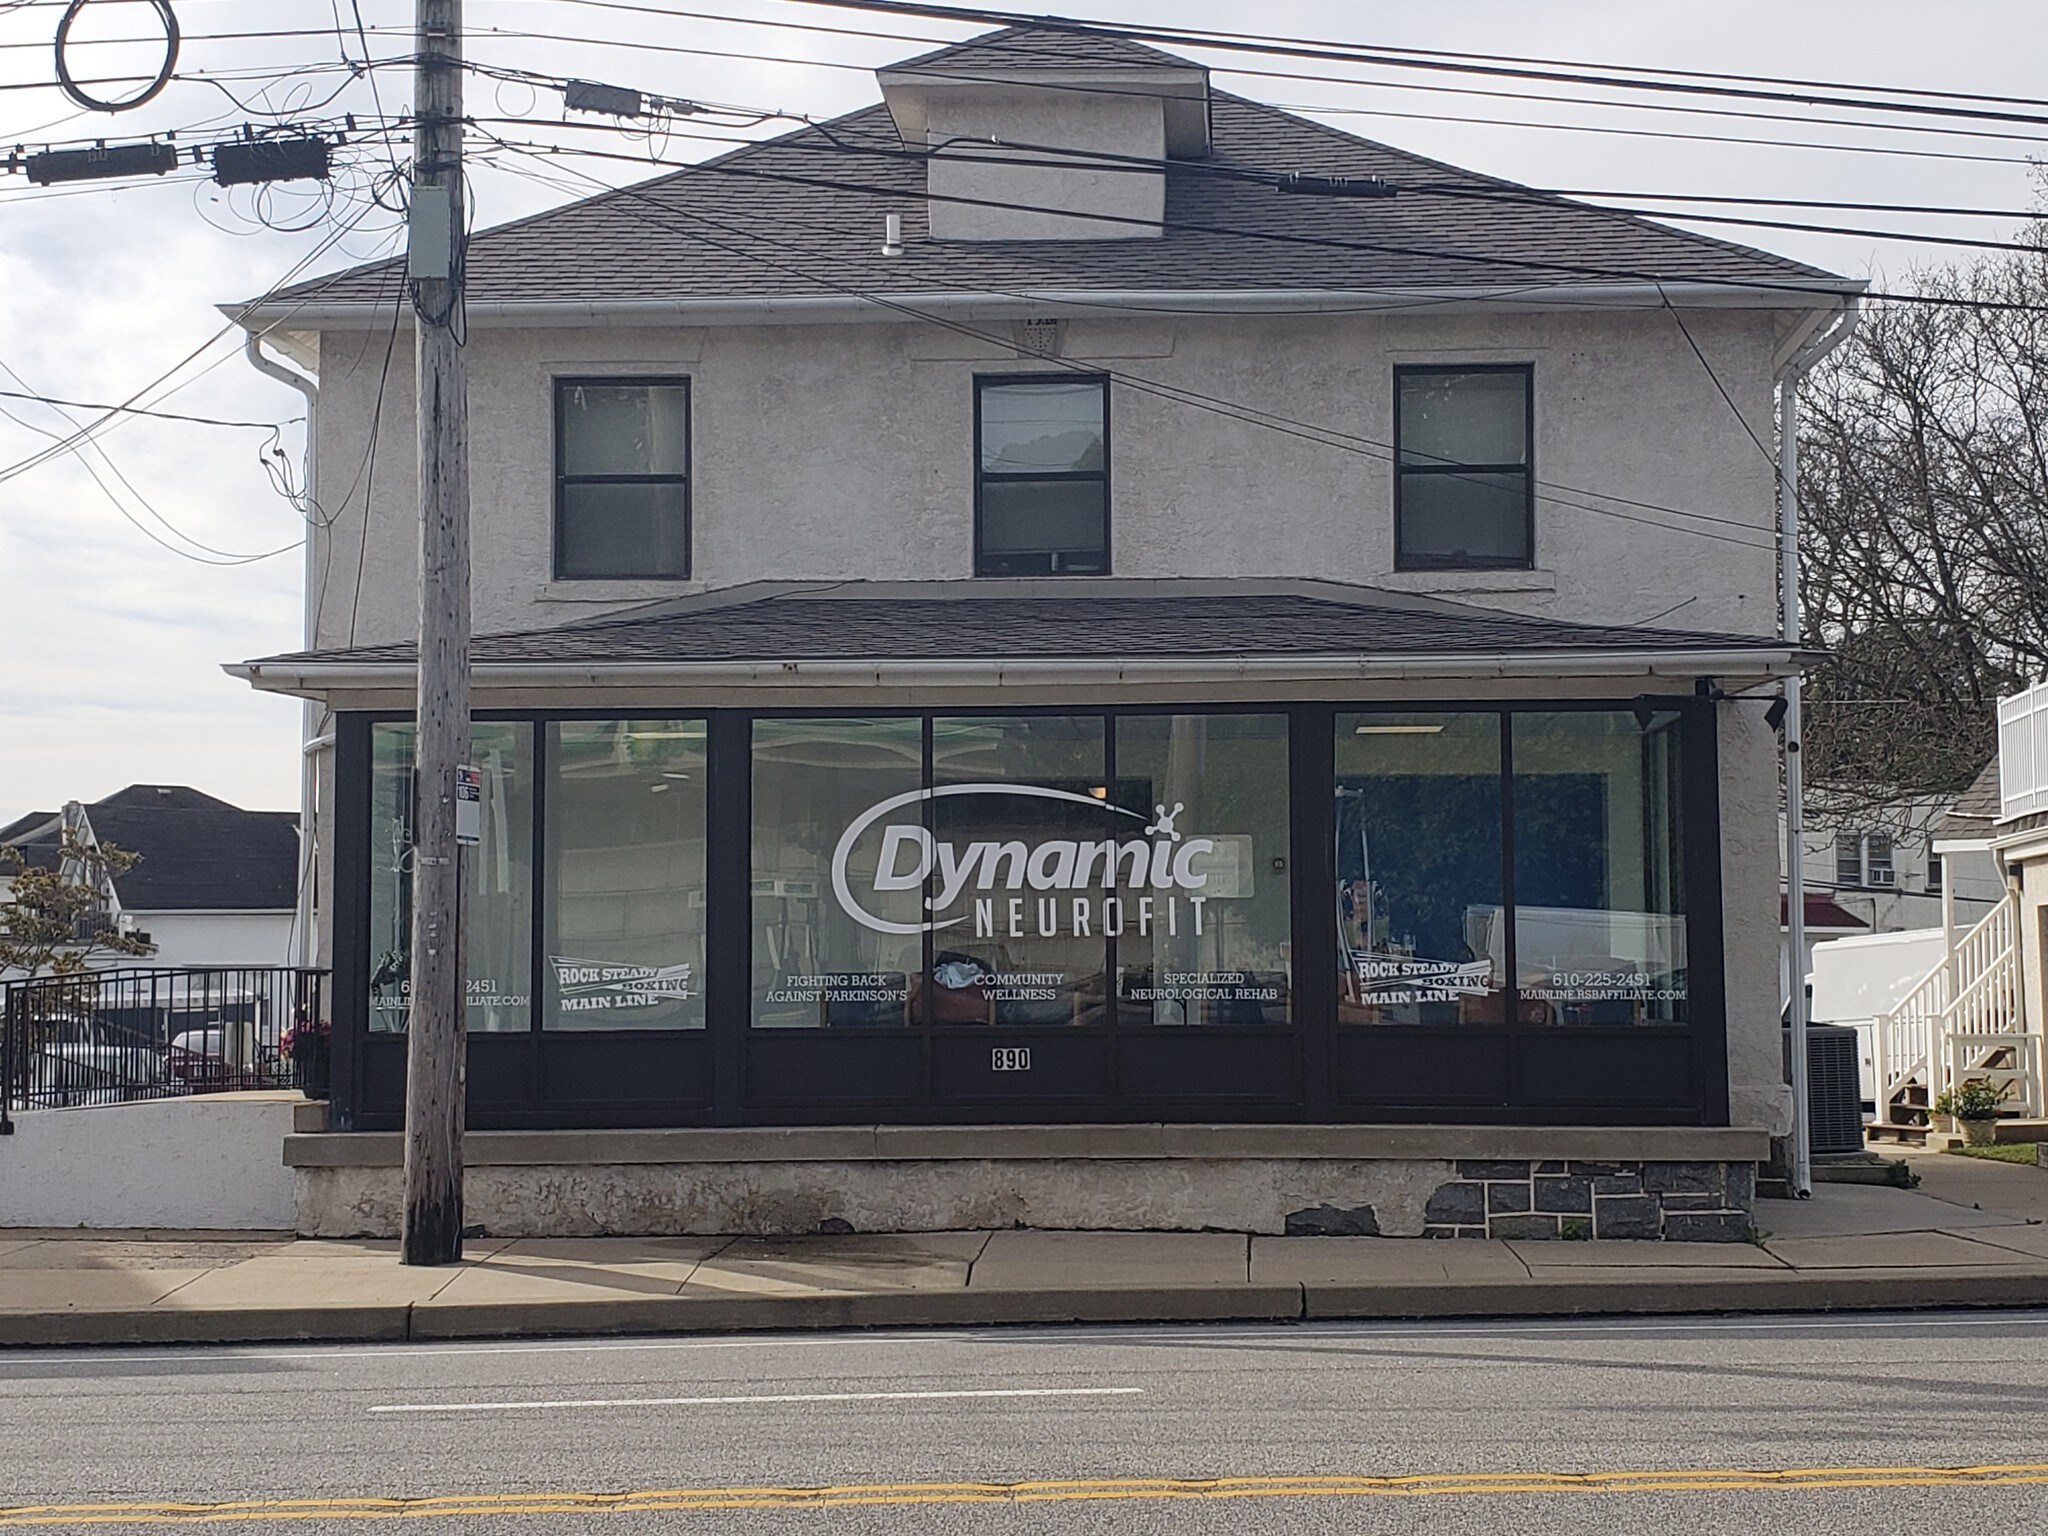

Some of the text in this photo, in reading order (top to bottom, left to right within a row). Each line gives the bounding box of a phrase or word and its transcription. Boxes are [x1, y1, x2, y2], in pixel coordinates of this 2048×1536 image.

[873, 820, 1213, 911] Dynamic
[974, 895, 1209, 938] NEUROFIT
[558, 967, 658, 985] ROCK STEADY
[1357, 961, 1459, 979] ROCK STEADY
[620, 978, 689, 992] BOXING
[786, 974, 887, 987] FIGHTING BACK
[974, 973, 1065, 986] COMMUNITY
[1163, 972, 1245, 985] SPECIALIZED
[1420, 974, 1489, 988] BOXING
[1552, 972, 1652, 987] 610-225-2451
[765, 990, 908, 1003] AGAINST PARKINSON'S
[981, 989, 1057, 1001] WELLNESS
[1130, 988, 1278, 1001] NEUROLOGICAL REHAB
[1360, 989, 1460, 1006] MAIN LINE
[1519, 989, 1687, 1001] MAINLINE.RSBAFFILIATE.COM
[560, 993, 659, 1011] MAIN LINE
[994, 1049, 1028, 1070] 890
